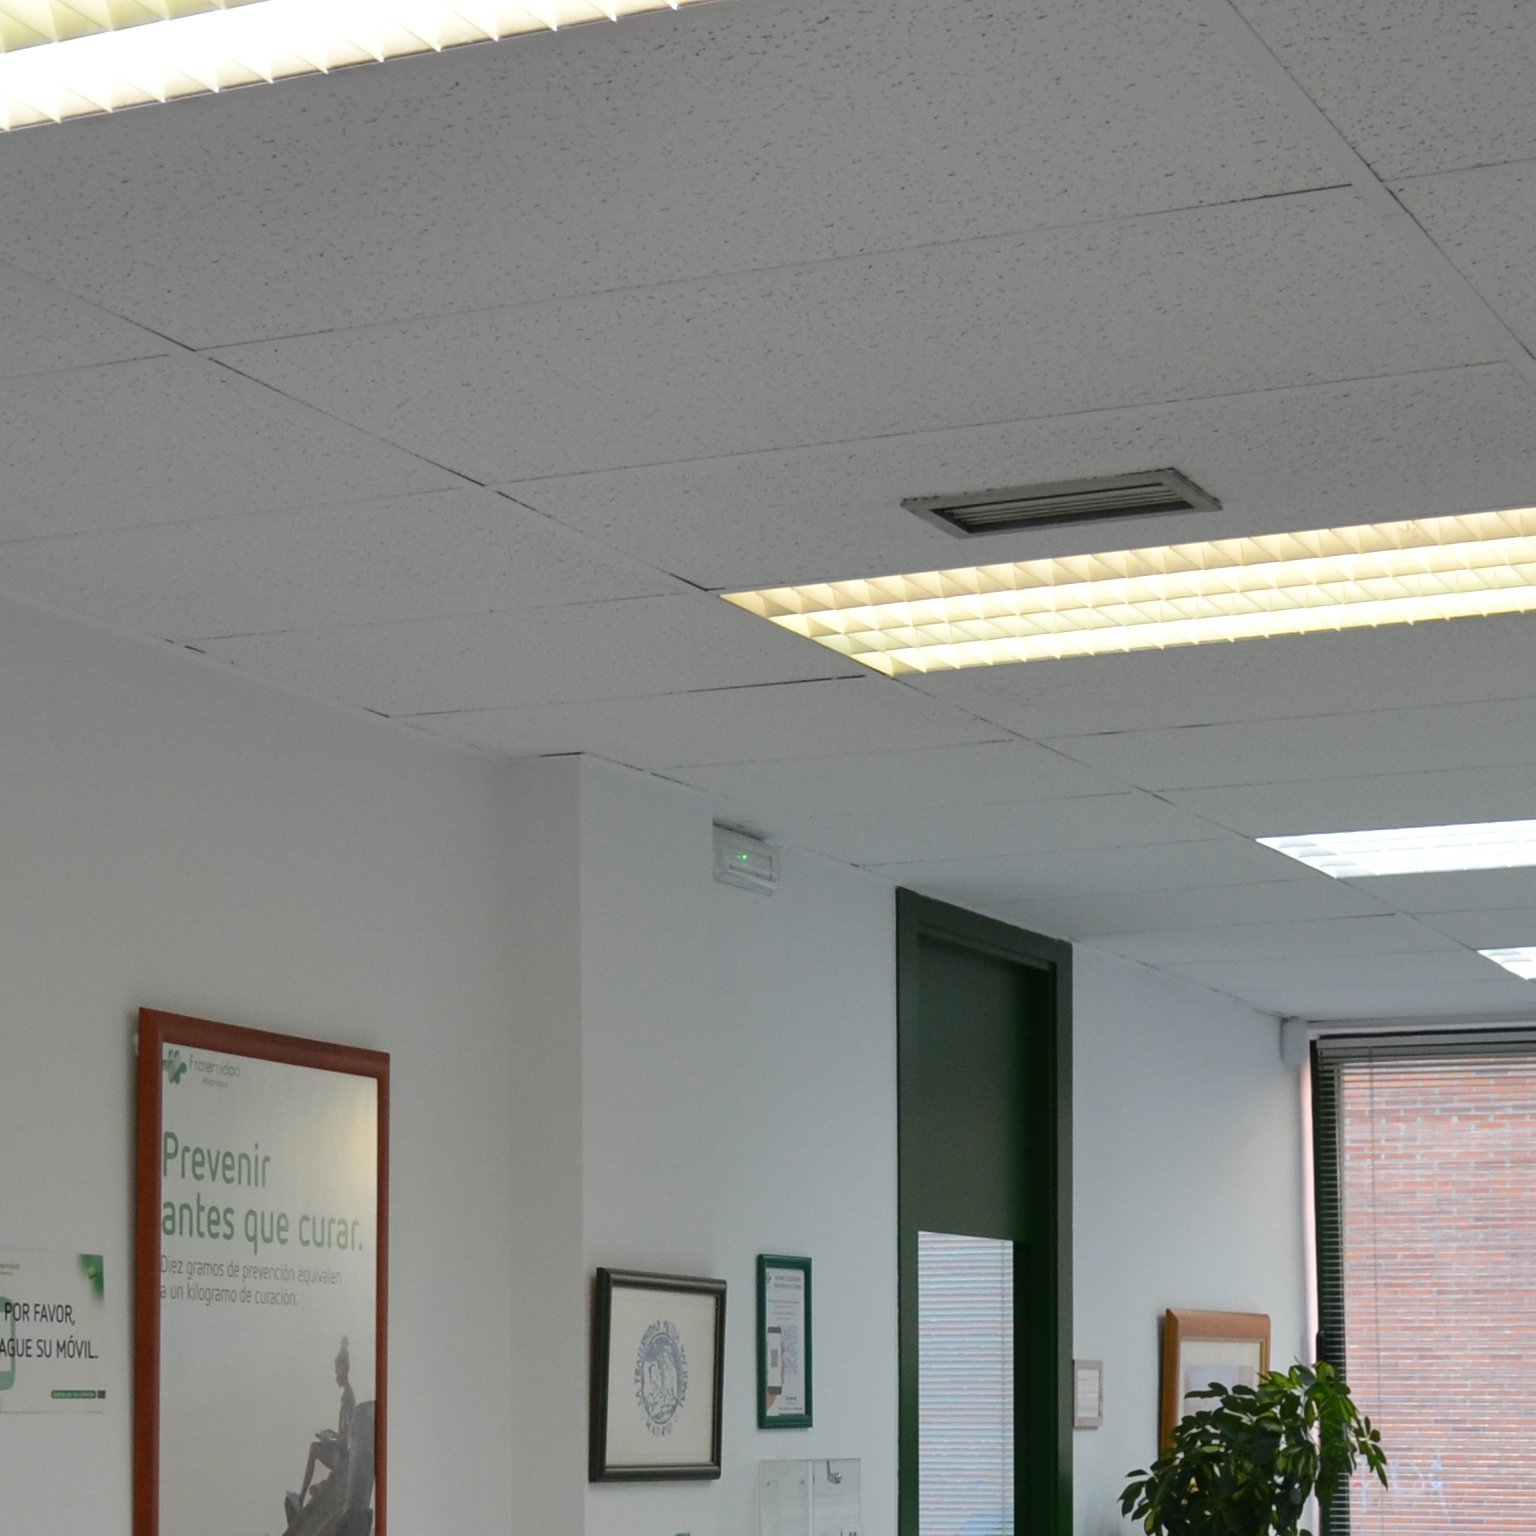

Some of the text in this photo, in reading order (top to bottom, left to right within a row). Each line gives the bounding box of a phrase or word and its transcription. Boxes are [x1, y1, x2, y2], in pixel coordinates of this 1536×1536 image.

[163, 1131, 271, 1188] Prevenir
[162, 1192, 363, 1255] antes que curar.
[161, 1255, 183, 1274] Diez
[186, 1261, 224, 1280] gramos
[227, 1261, 240, 1278] de
[242, 1264, 295, 1282] prevención
[170, 1285, 183, 1300] un
[187, 1282, 237, 1306] kilogramo
[240, 1286, 252, 1303] de
[4, 1302, 75, 1326] POR FAVOR,
[36, 1339, 52, 1358] SU
[56, 1335, 99, 1359] MÓVIL.
